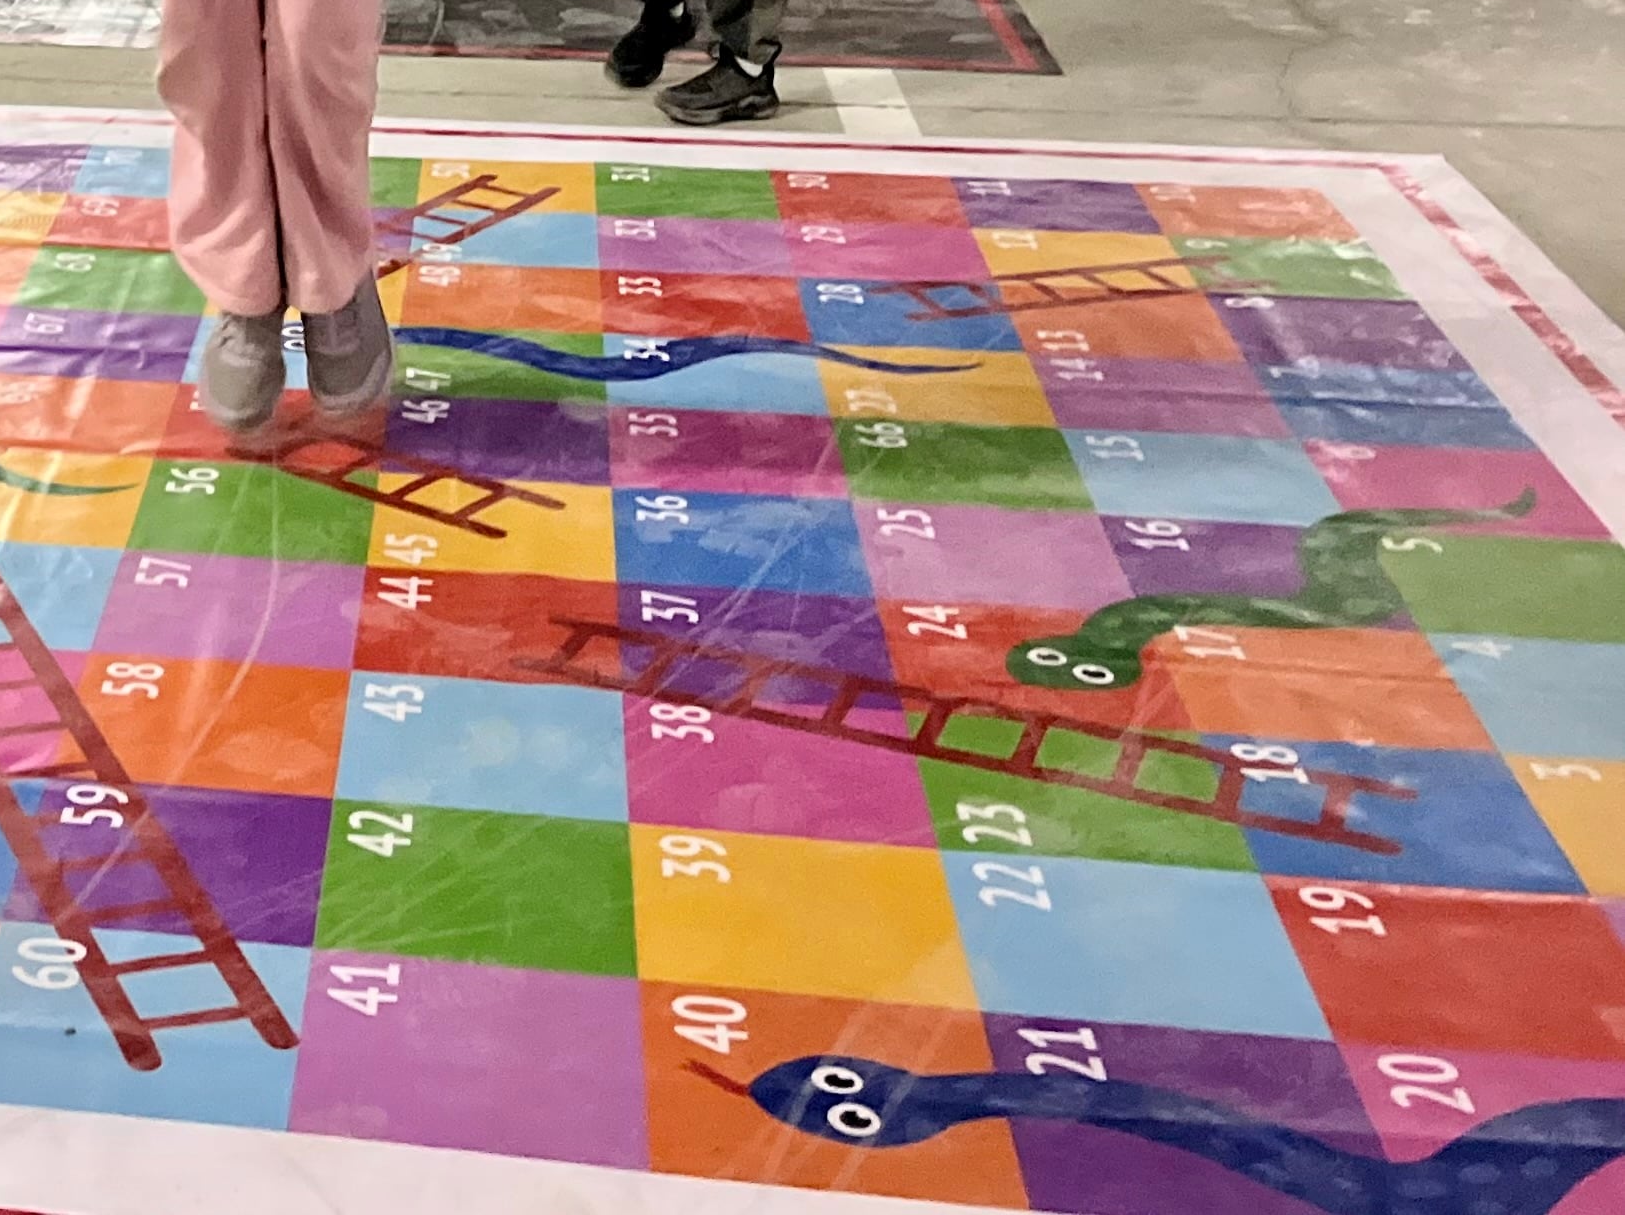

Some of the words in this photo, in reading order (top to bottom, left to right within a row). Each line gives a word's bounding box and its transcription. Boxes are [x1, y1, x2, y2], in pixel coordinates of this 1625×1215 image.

[614, 219, 657, 240] 32
[418, 265, 462, 288] 48
[618, 276, 663, 297] 33
[24, 312, 66, 334] 67
[624, 337, 671, 362] 34
[1037, 330, 1090, 352] 13
[405, 367, 451, 391] 47
[1050, 358, 1104, 381] 14
[401, 399, 451, 424] 46
[628, 411, 679, 438] 35
[1085, 433, 1145, 463] 15
[165, 467, 220, 494] 56
[635, 495, 690, 526] 36
[877, 507, 936, 541] 25
[383, 533, 439, 565] 45
[1124, 517, 1191, 553] 16
[1381, 536, 1443, 554] 5
[135, 556, 192, 589] 57
[377, 576, 433, 610] 44
[641, 590, 700, 625] 37
[908, 604, 969, 641] 24
[1175, 624, 1247, 662] 17
[1451, 637, 1513, 660] 4
[101, 661, 164, 699] 58
[363, 683, 425, 722] 43
[651, 704, 715, 744] 38
[1230, 742, 1311, 784] 18
[1529, 761, 1604, 784] 3
[60, 784, 130, 829] 59
[347, 810, 414, 858] 42
[956, 801, 1033, 849] 23
[659, 834, 731, 883] 39
[972, 860, 1053, 913] 22
[1298, 885, 1387, 939] 19
[12, 936, 88, 990] 60
[327, 963, 402, 1016] 41
[671, 994, 749, 1056] 40
[1017, 1026, 1108, 1083] 21
[1377, 1052, 1476, 1115] 20
